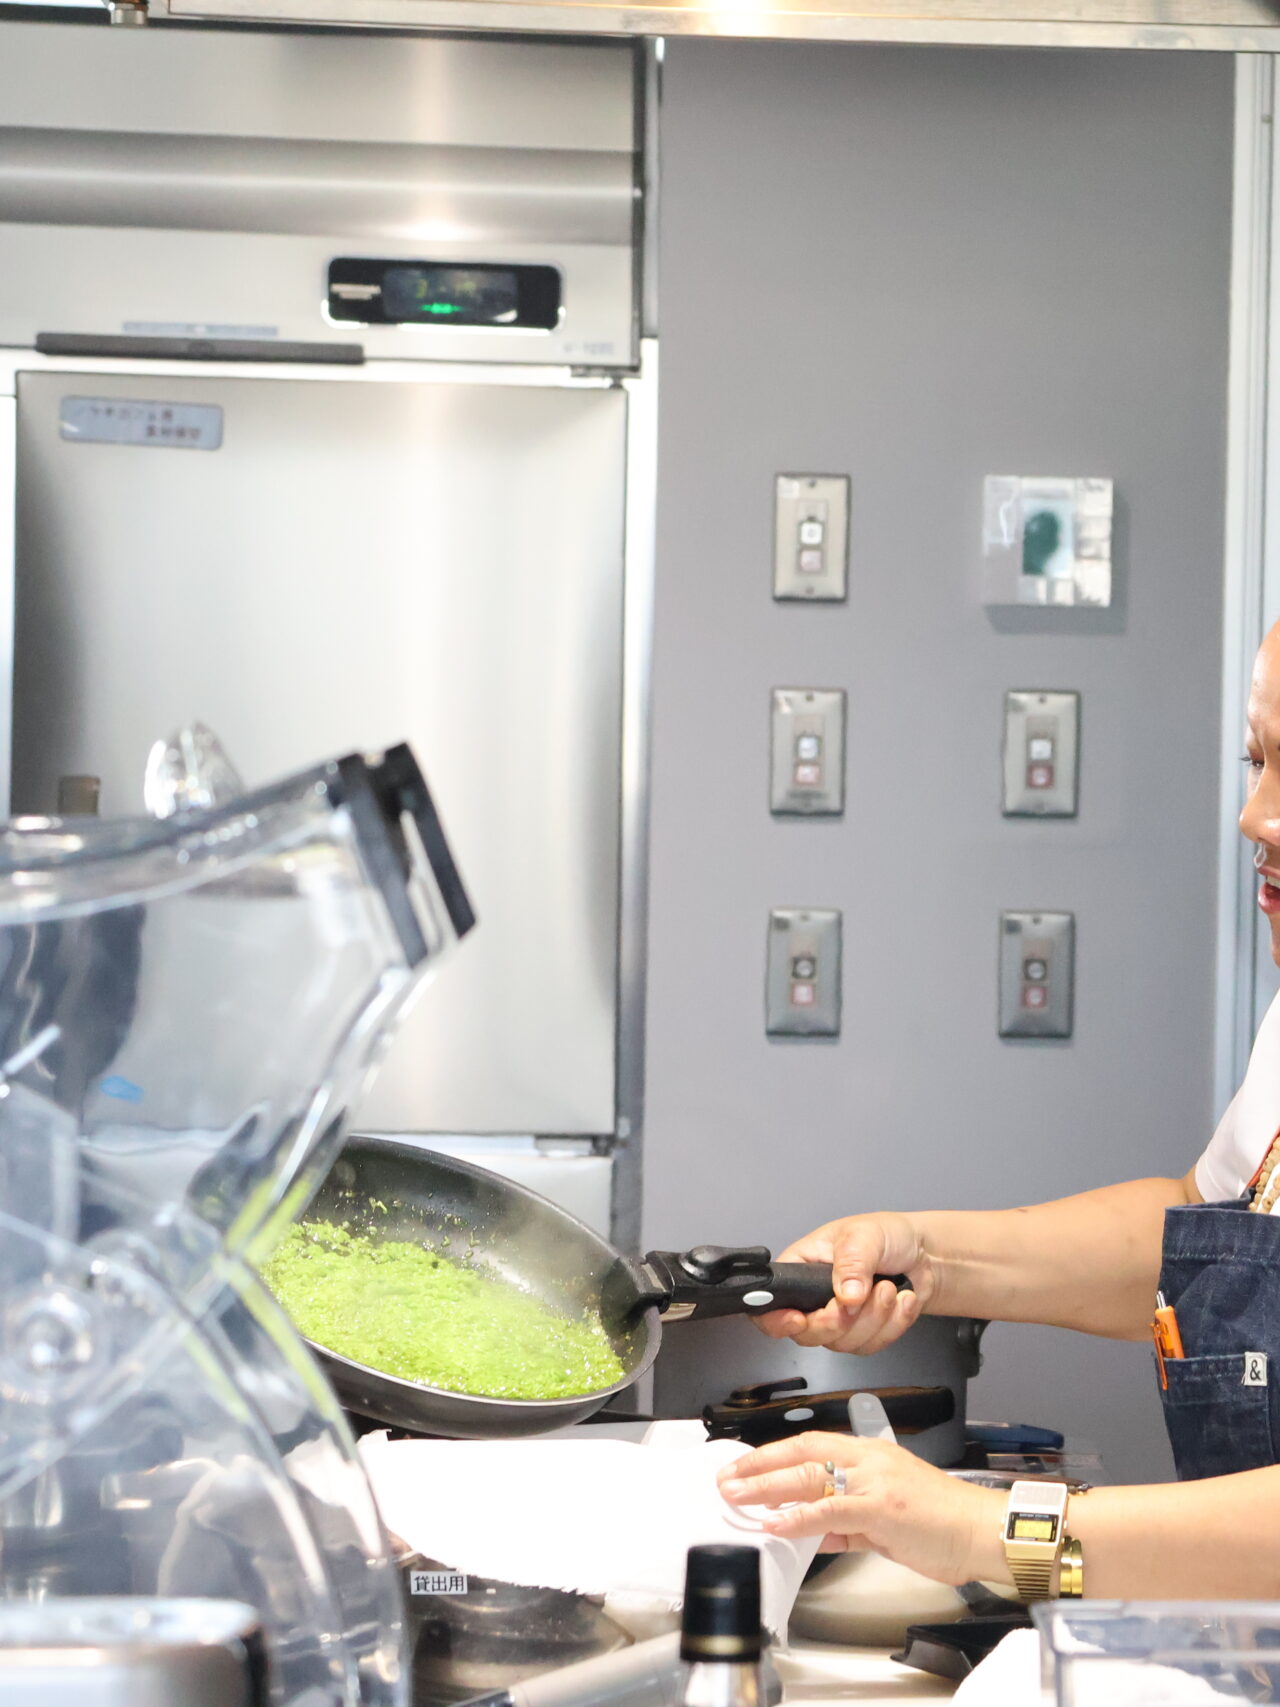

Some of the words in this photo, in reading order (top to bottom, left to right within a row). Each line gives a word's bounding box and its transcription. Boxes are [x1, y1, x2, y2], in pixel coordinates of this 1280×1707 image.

[1250, 1359, 1261, 1380] &
[413, 1575, 465, 1592] 貸出用
